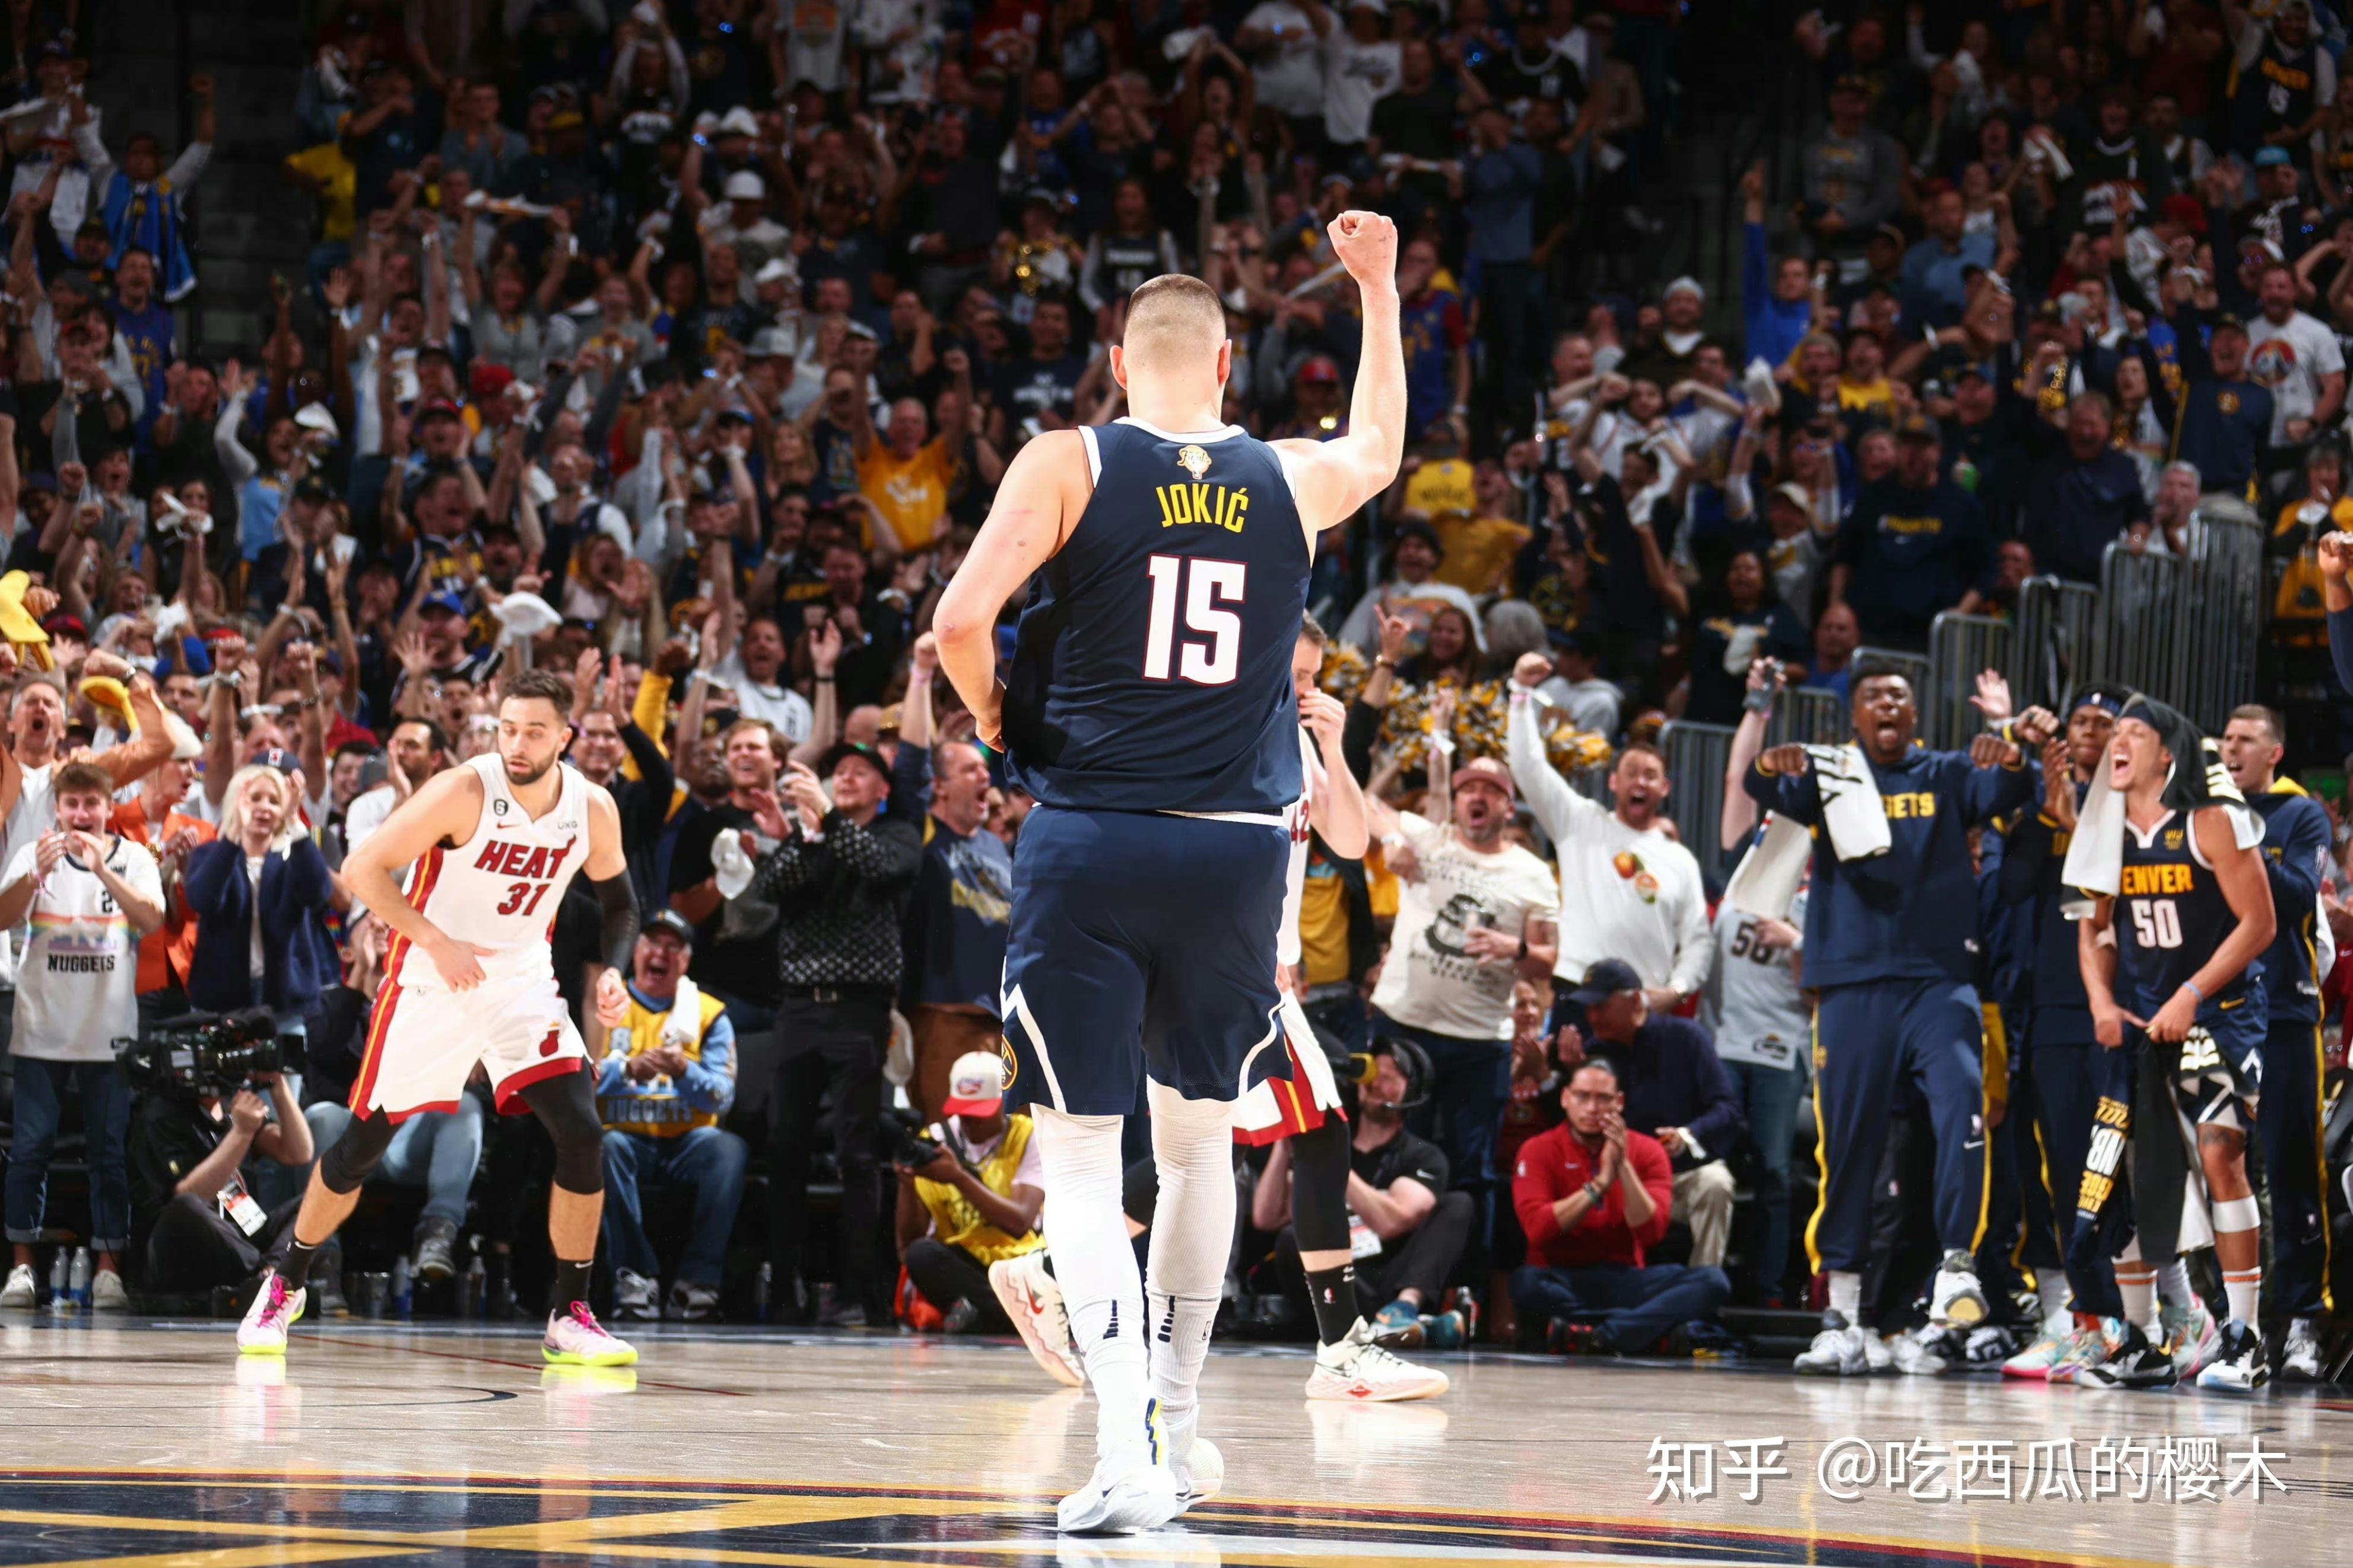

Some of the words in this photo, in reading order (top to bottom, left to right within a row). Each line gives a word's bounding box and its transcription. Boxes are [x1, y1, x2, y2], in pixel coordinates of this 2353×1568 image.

[1155, 483, 1249, 533] JOKIĆ
[1141, 553, 1247, 687] 15
[557, 821, 578, 829] UKG
[475, 834, 576, 879] HEAT
[497, 882, 550, 916] 31
[2121, 864, 2194, 895] ENVER
[2130, 899, 2183, 949] 50
[47, 953, 116, 974] NUGGETS
